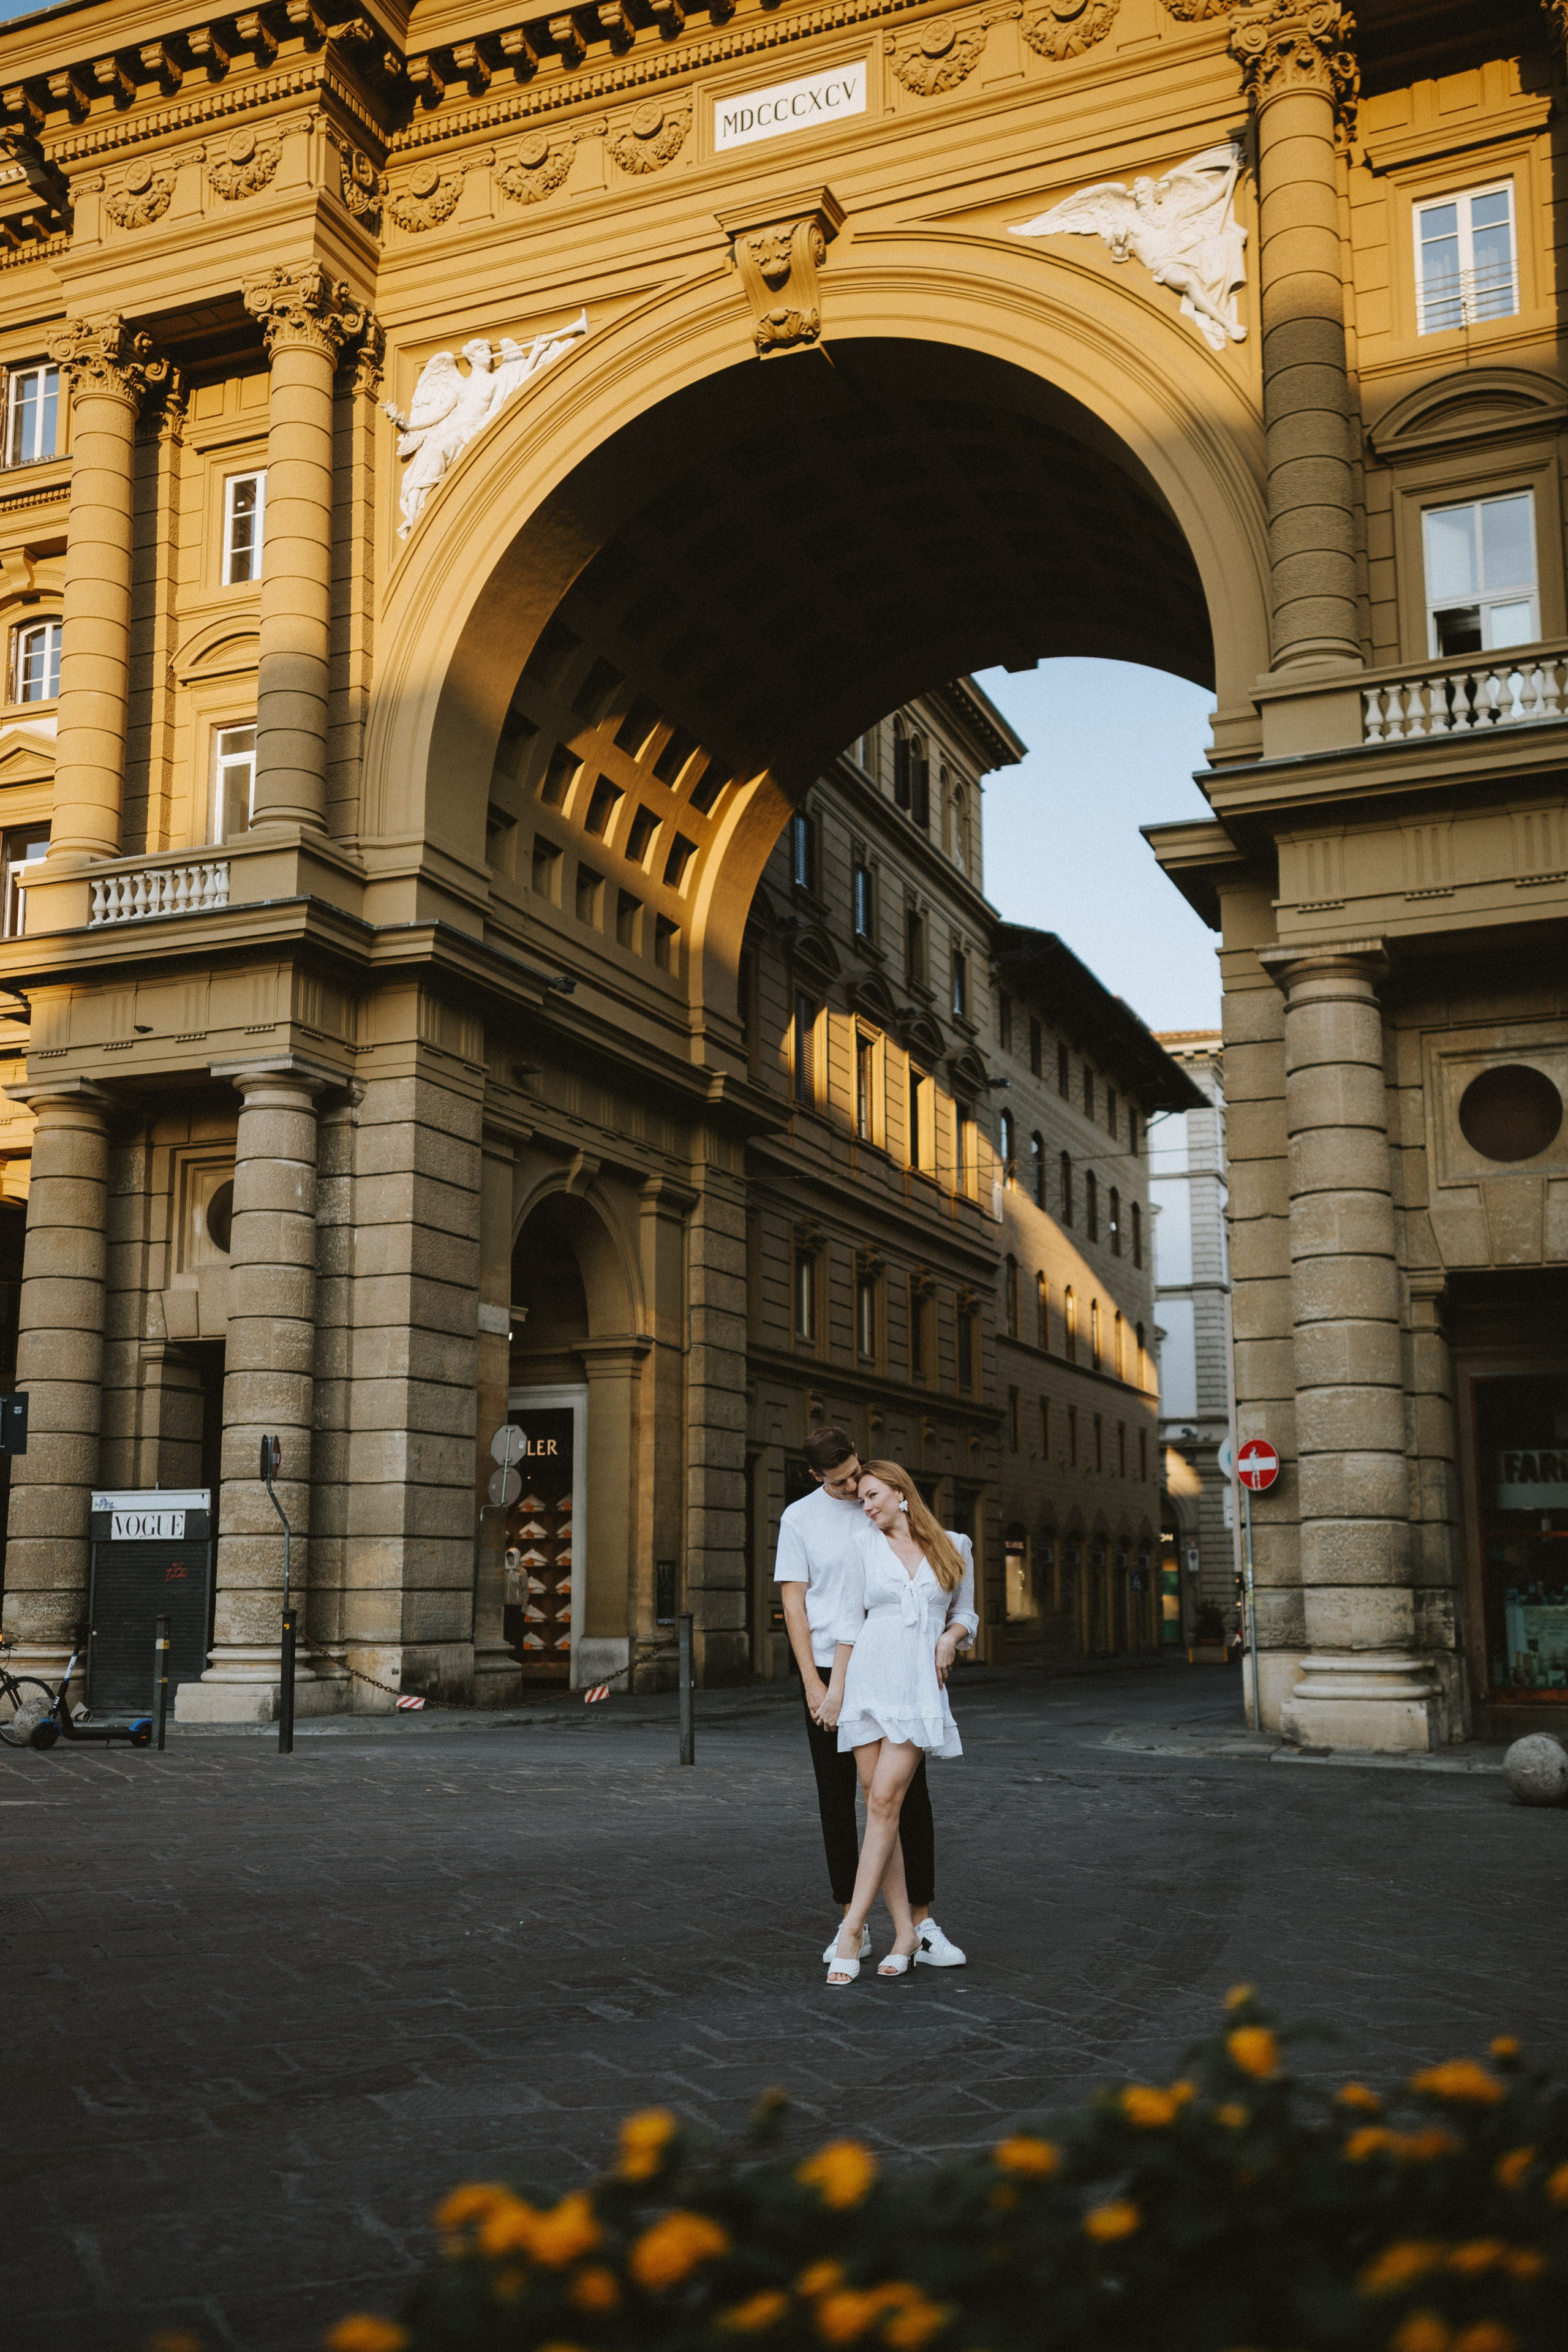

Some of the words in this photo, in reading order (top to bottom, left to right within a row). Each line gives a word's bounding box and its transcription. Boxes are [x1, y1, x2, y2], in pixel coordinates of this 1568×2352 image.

[723, 78, 856, 137] MDCCCXCV
[527, 1439, 558, 1456] LER
[115, 1515, 183, 1537] VOGUE
